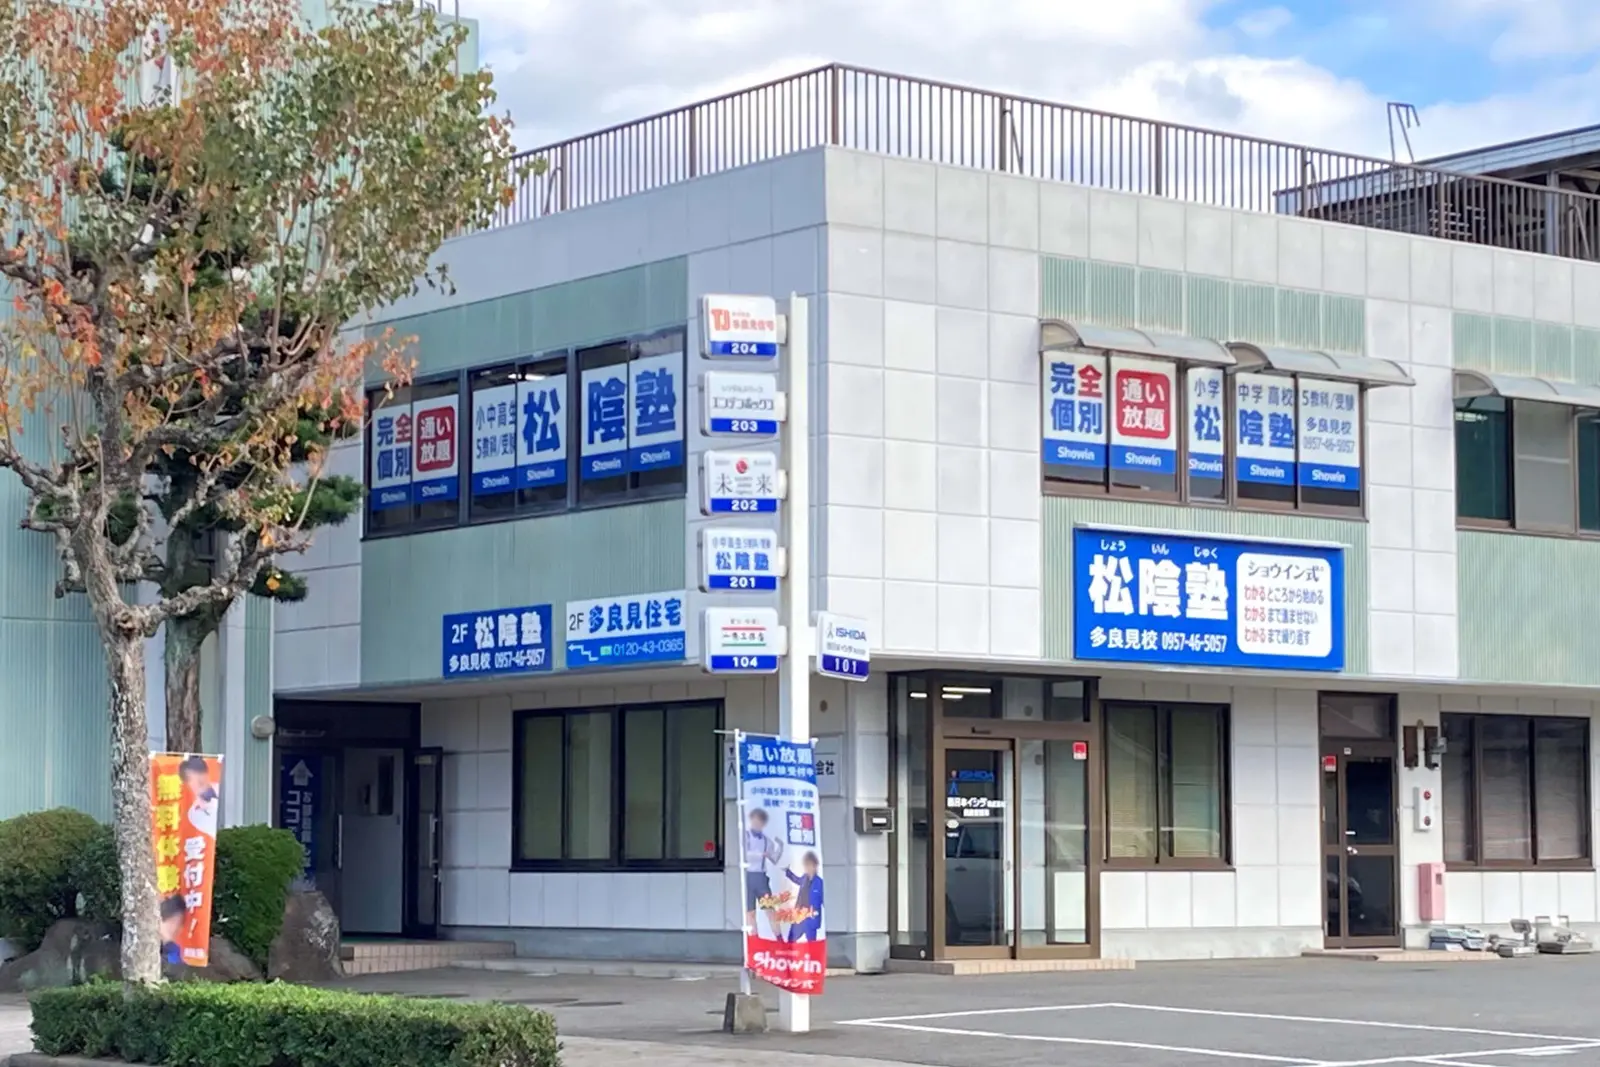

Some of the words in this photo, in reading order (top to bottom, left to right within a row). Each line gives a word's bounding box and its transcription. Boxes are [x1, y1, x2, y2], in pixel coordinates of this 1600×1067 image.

[731, 343, 757, 354] 204
[1050, 362, 1103, 398] 完全
[1122, 378, 1165, 403] 通い
[1194, 378, 1220, 399] 小学
[1238, 383, 1263, 404] 中学
[1268, 385, 1295, 407] 高校
[1302, 390, 1355, 412] 5教科/受験
[731, 421, 758, 432] 203
[1050, 398, 1103, 435] 個別
[1122, 405, 1165, 432] 放題
[1306, 416, 1352, 436] 多良見校
[376, 412, 412, 447] 完全
[420, 415, 451, 440] 通い
[376, 444, 412, 480] 個別
[420, 441, 451, 466] 放題
[640, 449, 671, 465] Showin
[1057, 446, 1095, 461] Showin
[1125, 452, 1161, 467] Showin
[526, 466, 555, 482] Showin
[592, 457, 621, 472] Showin
[1188, 459, 1222, 473] Showin
[1250, 464, 1285, 478] Showin
[482, 474, 510, 489] Showin
[1312, 469, 1346, 483] Showin
[381, 489, 406, 504] Showin
[421, 483, 448, 498] Showin
[731, 500, 758, 511] 202
[1100, 539, 1126, 552] しょう
[1151, 543, 1170, 555] いん
[1193, 546, 1218, 560] じゅく
[716, 552, 769, 571] 松陰塾
[1248, 560, 1319, 582] ショウイン式
[730, 577, 756, 588] 201
[1088, 553, 1229, 620] 松陰塾
[569, 613, 584, 632] 2F
[588, 598, 681, 634] 多良見住宅
[451, 623, 468, 644] 2F
[475, 611, 542, 650] 松陰塾
[835, 627, 867, 641] ISHIDA
[1090, 626, 1158, 650] 多良見校
[1162, 632, 1227, 653] 0957-46-5057
[449, 652, 491, 673] 多良見校
[495, 648, 545, 669] 0957-46-5057
[733, 656, 758, 667] 104
[835, 658, 857, 673] 101
[747, 744, 812, 765] 通い放題
[753, 951, 821, 973] Showin
